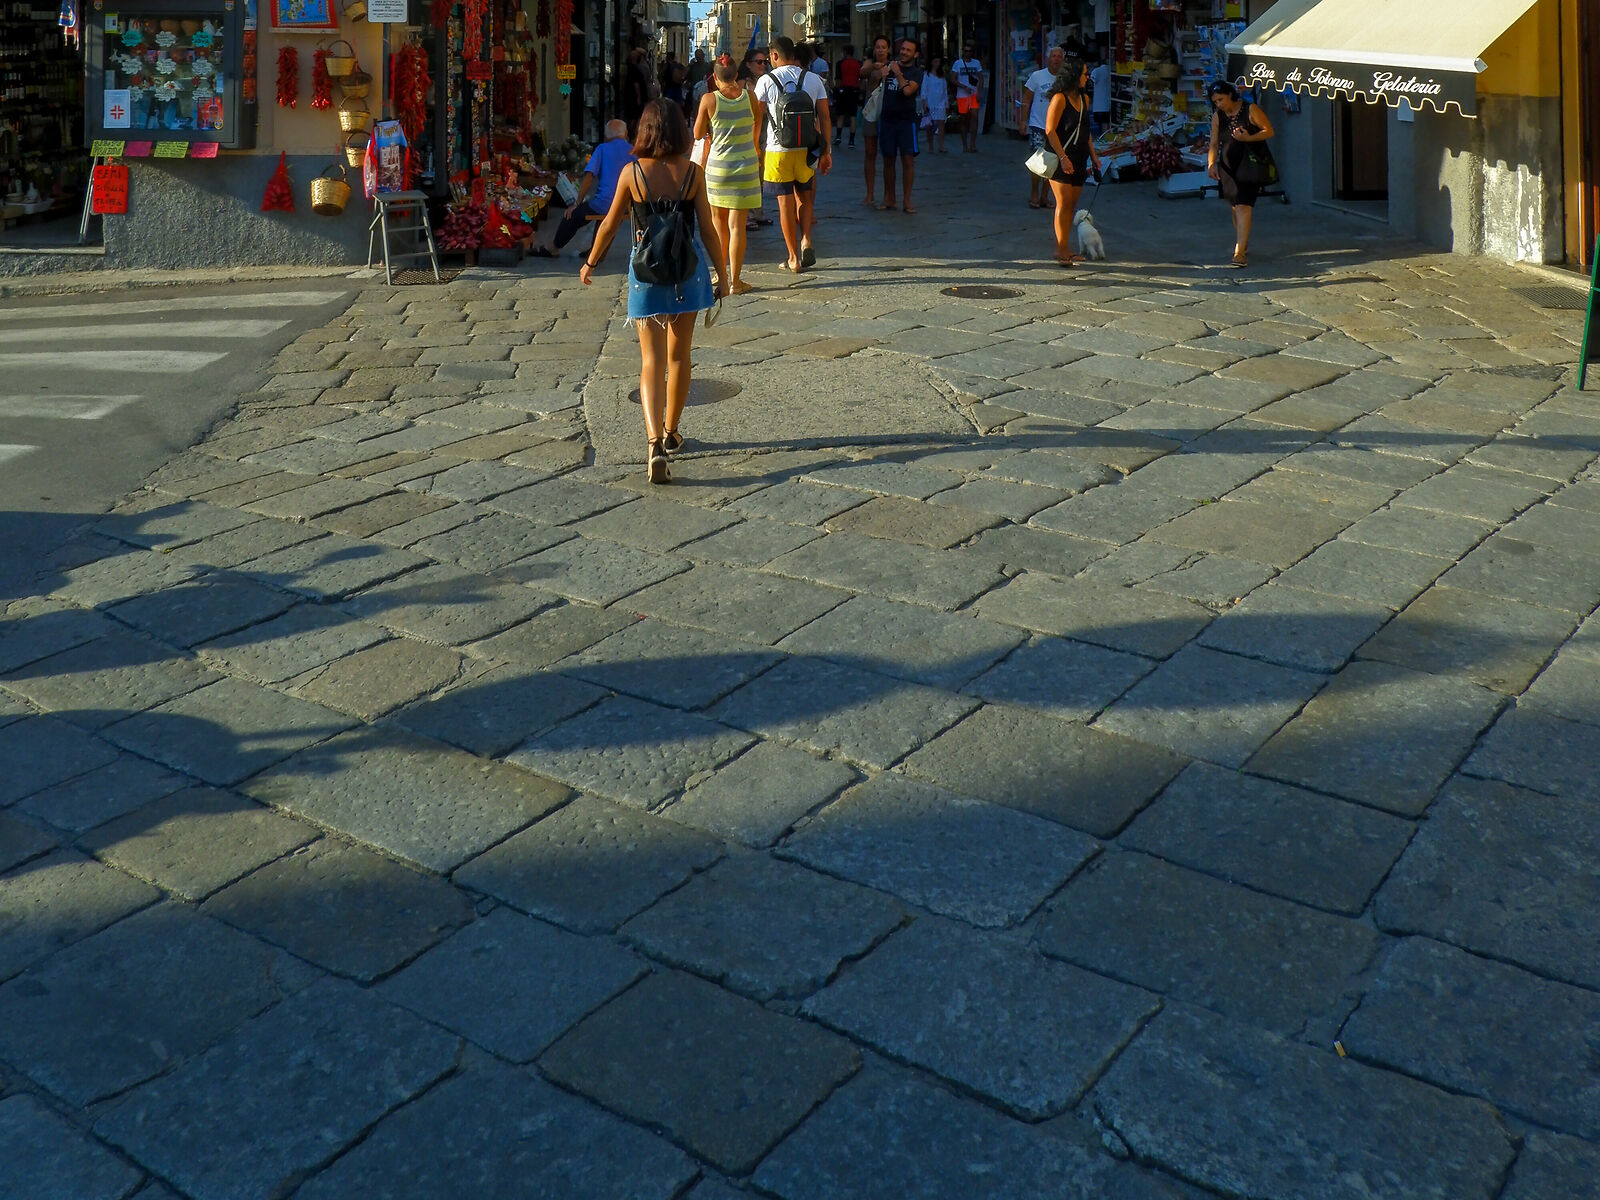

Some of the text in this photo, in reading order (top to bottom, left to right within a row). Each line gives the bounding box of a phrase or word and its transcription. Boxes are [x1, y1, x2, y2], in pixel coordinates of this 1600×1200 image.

[1249, 62, 1441, 96] Bar da Totonno Gelateria
